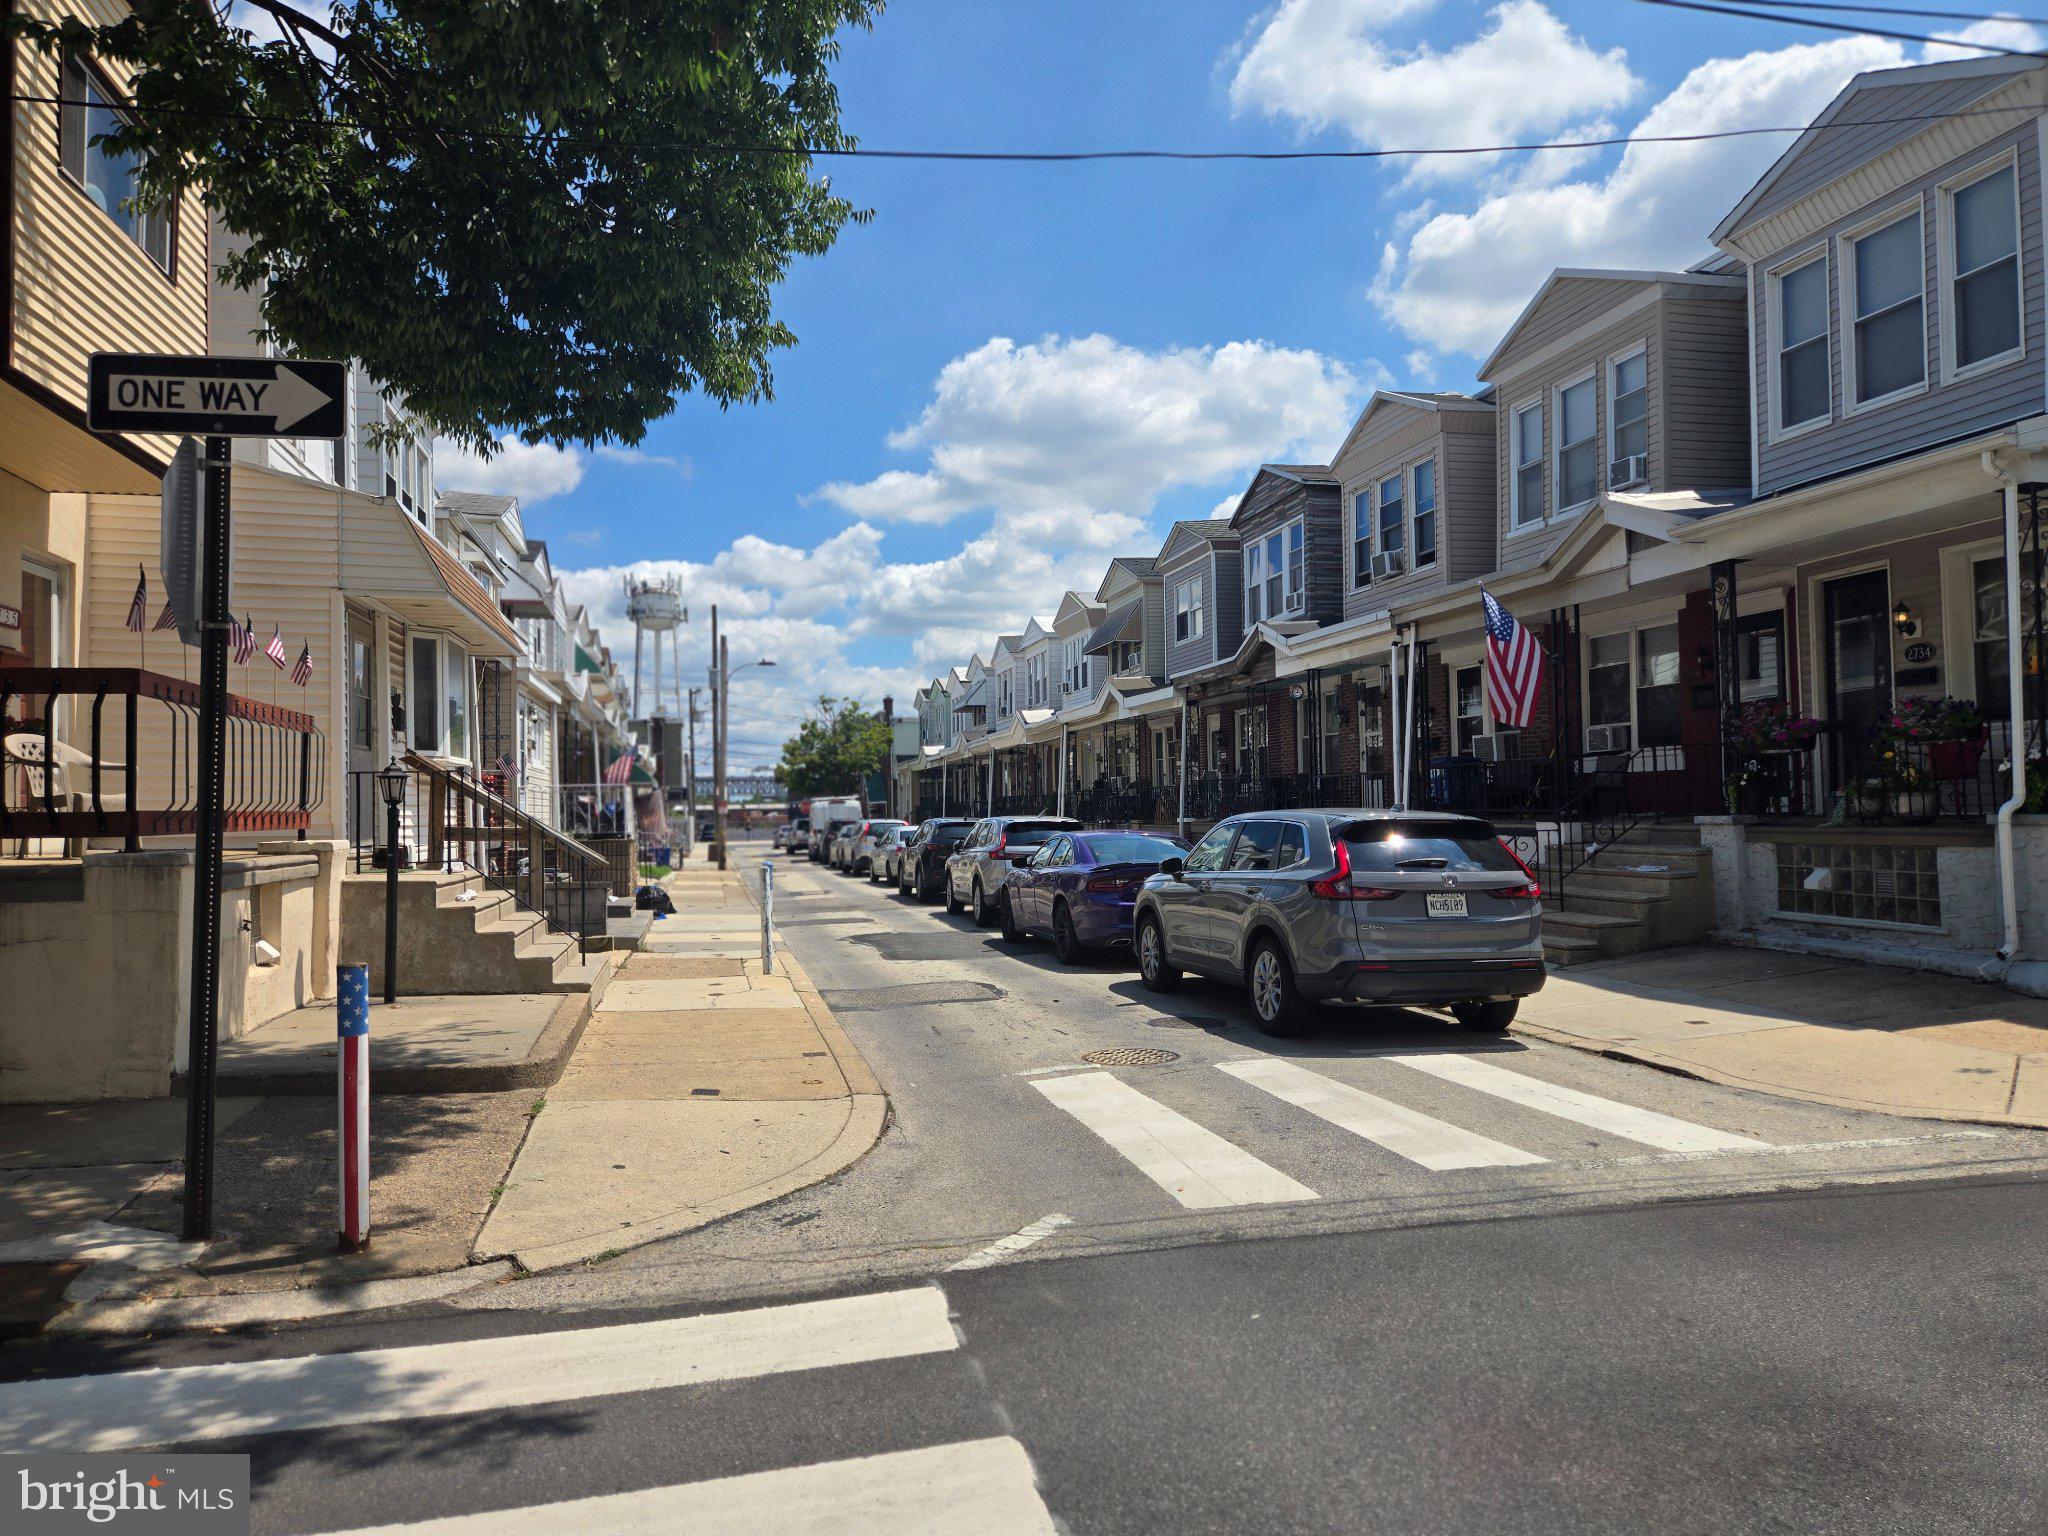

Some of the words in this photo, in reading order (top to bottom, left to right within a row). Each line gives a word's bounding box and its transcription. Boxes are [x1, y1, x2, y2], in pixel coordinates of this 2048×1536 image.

[117, 379, 185, 409] ONE
[199, 381, 269, 412] WAY
[0, 609, 17, 626] 35
[1908, 647, 1931, 660] 2734
